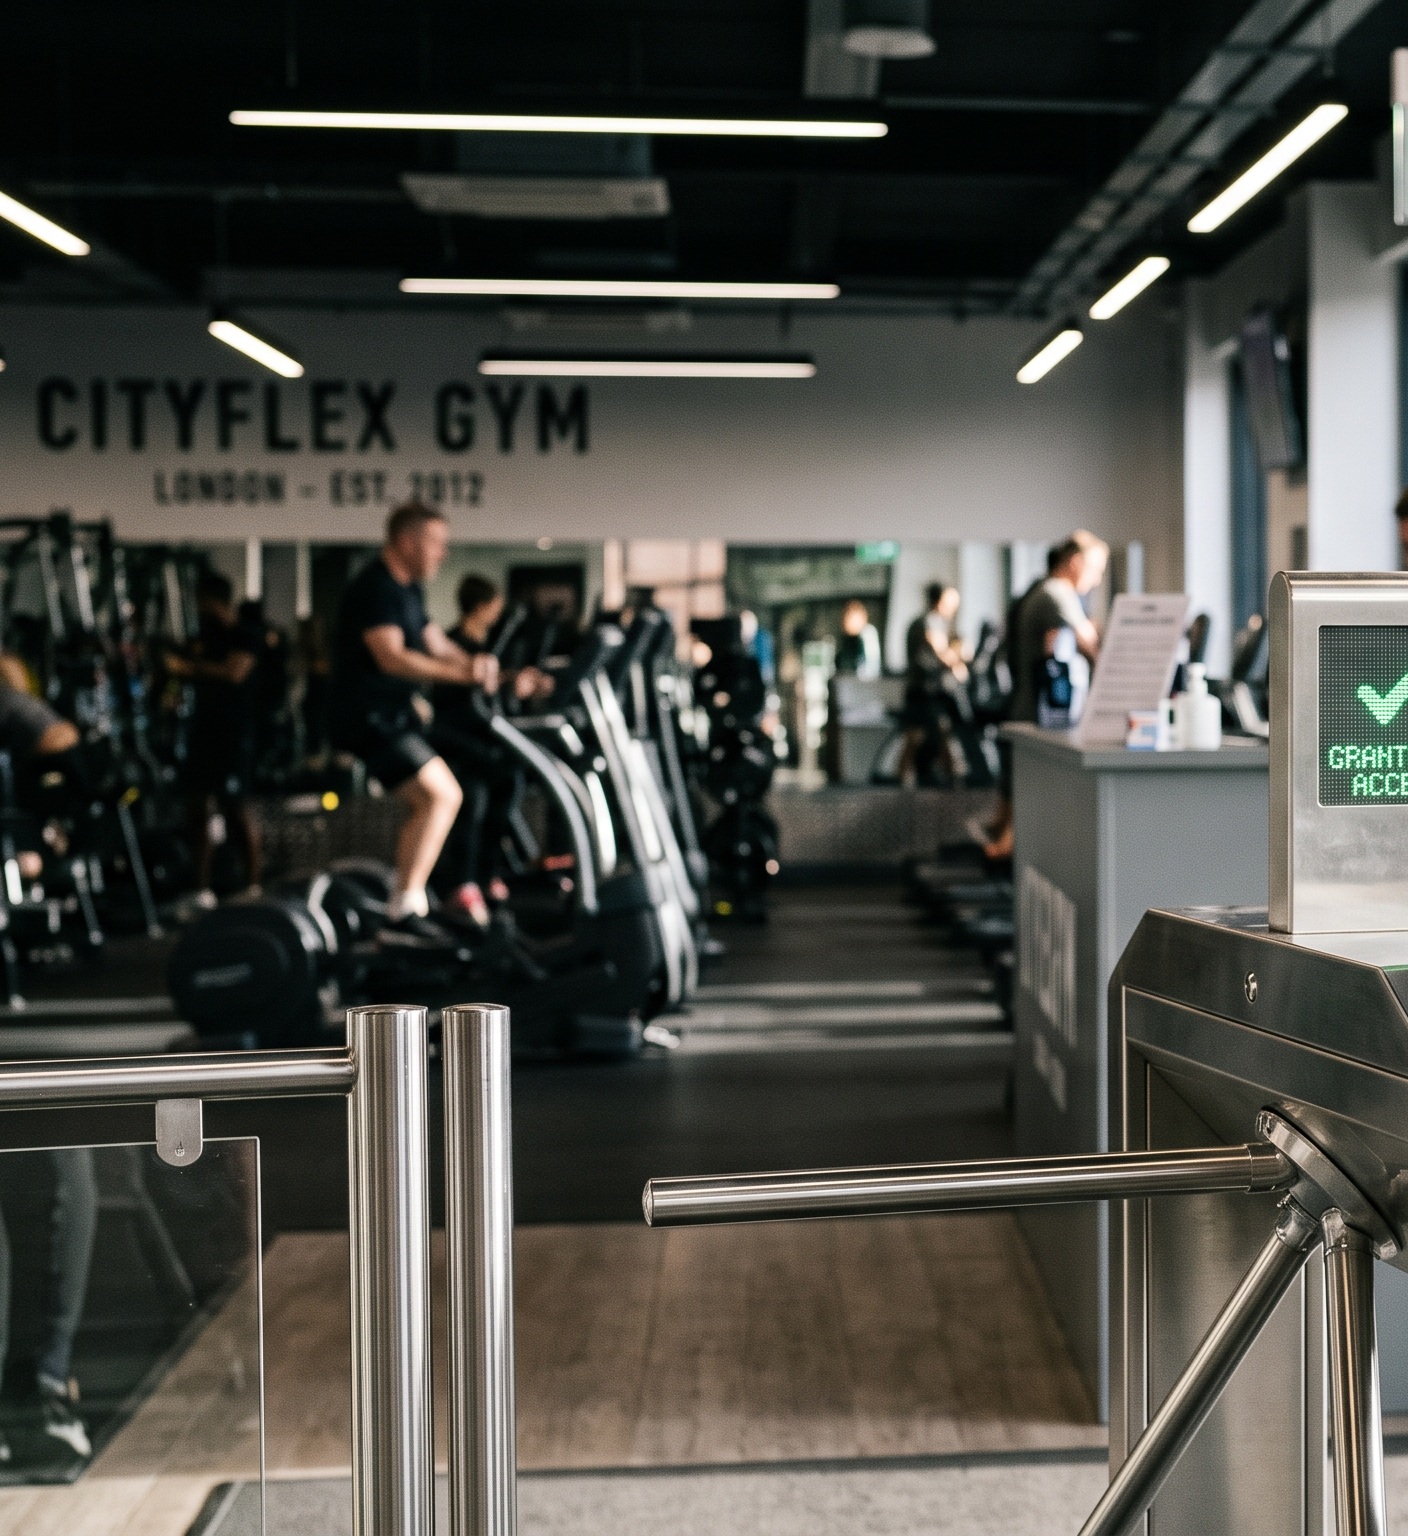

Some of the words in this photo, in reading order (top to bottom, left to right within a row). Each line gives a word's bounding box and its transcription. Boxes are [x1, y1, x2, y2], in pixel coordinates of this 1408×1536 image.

[37, 378, 396, 454] CITYFLEX
[435, 378, 589, 455] GYM
[152, 469, 288, 506] LONDON
[409, 469, 484, 507] 2012
